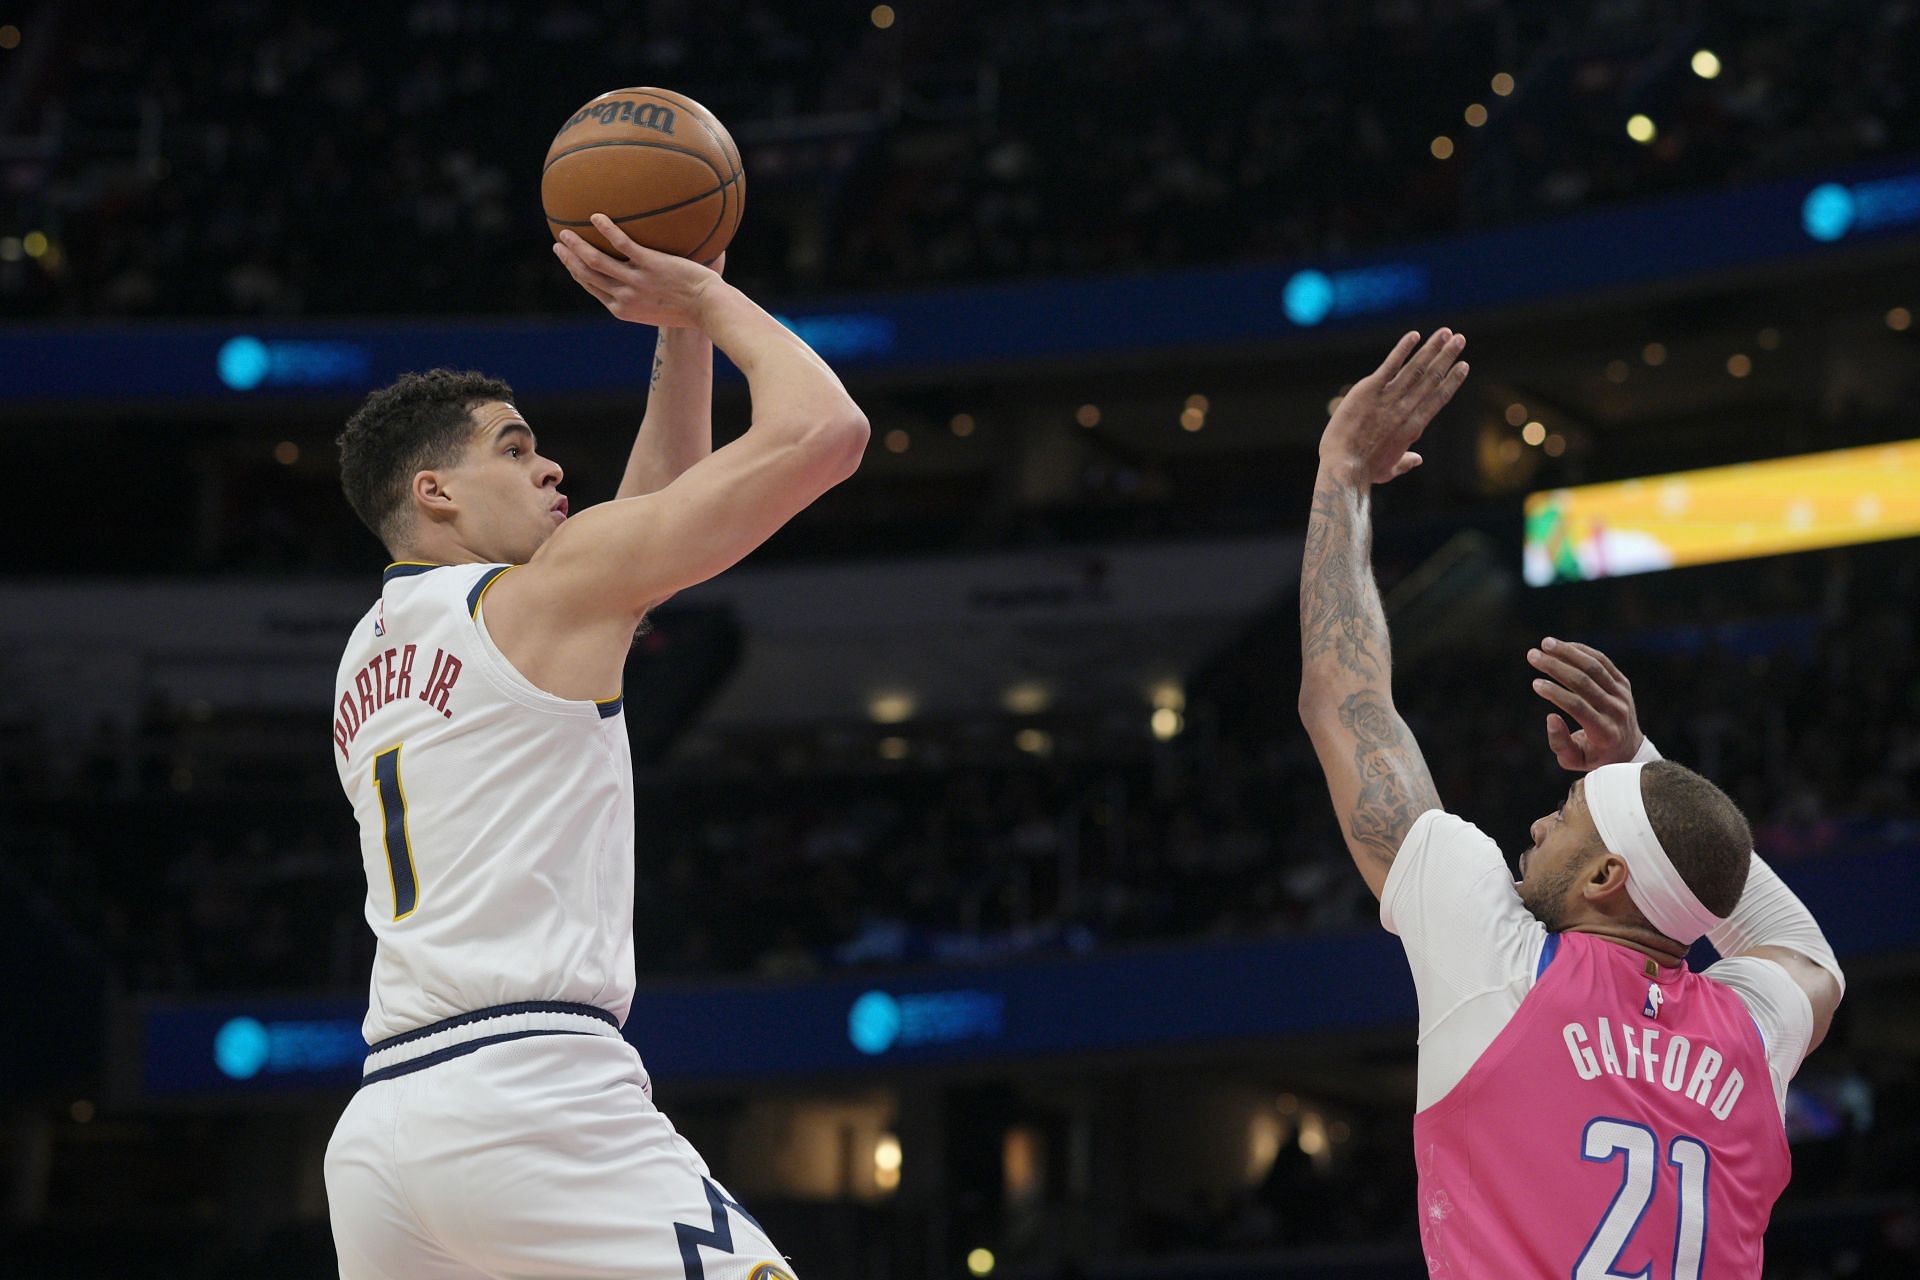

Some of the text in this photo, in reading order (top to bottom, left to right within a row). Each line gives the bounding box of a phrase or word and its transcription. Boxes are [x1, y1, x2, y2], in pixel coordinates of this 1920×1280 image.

[333, 643, 463, 763] PORTER JR.
[372, 742, 420, 923] 1
[1562, 1016, 1745, 1121] GAFFORD
[1572, 1115, 1710, 1280] 21
